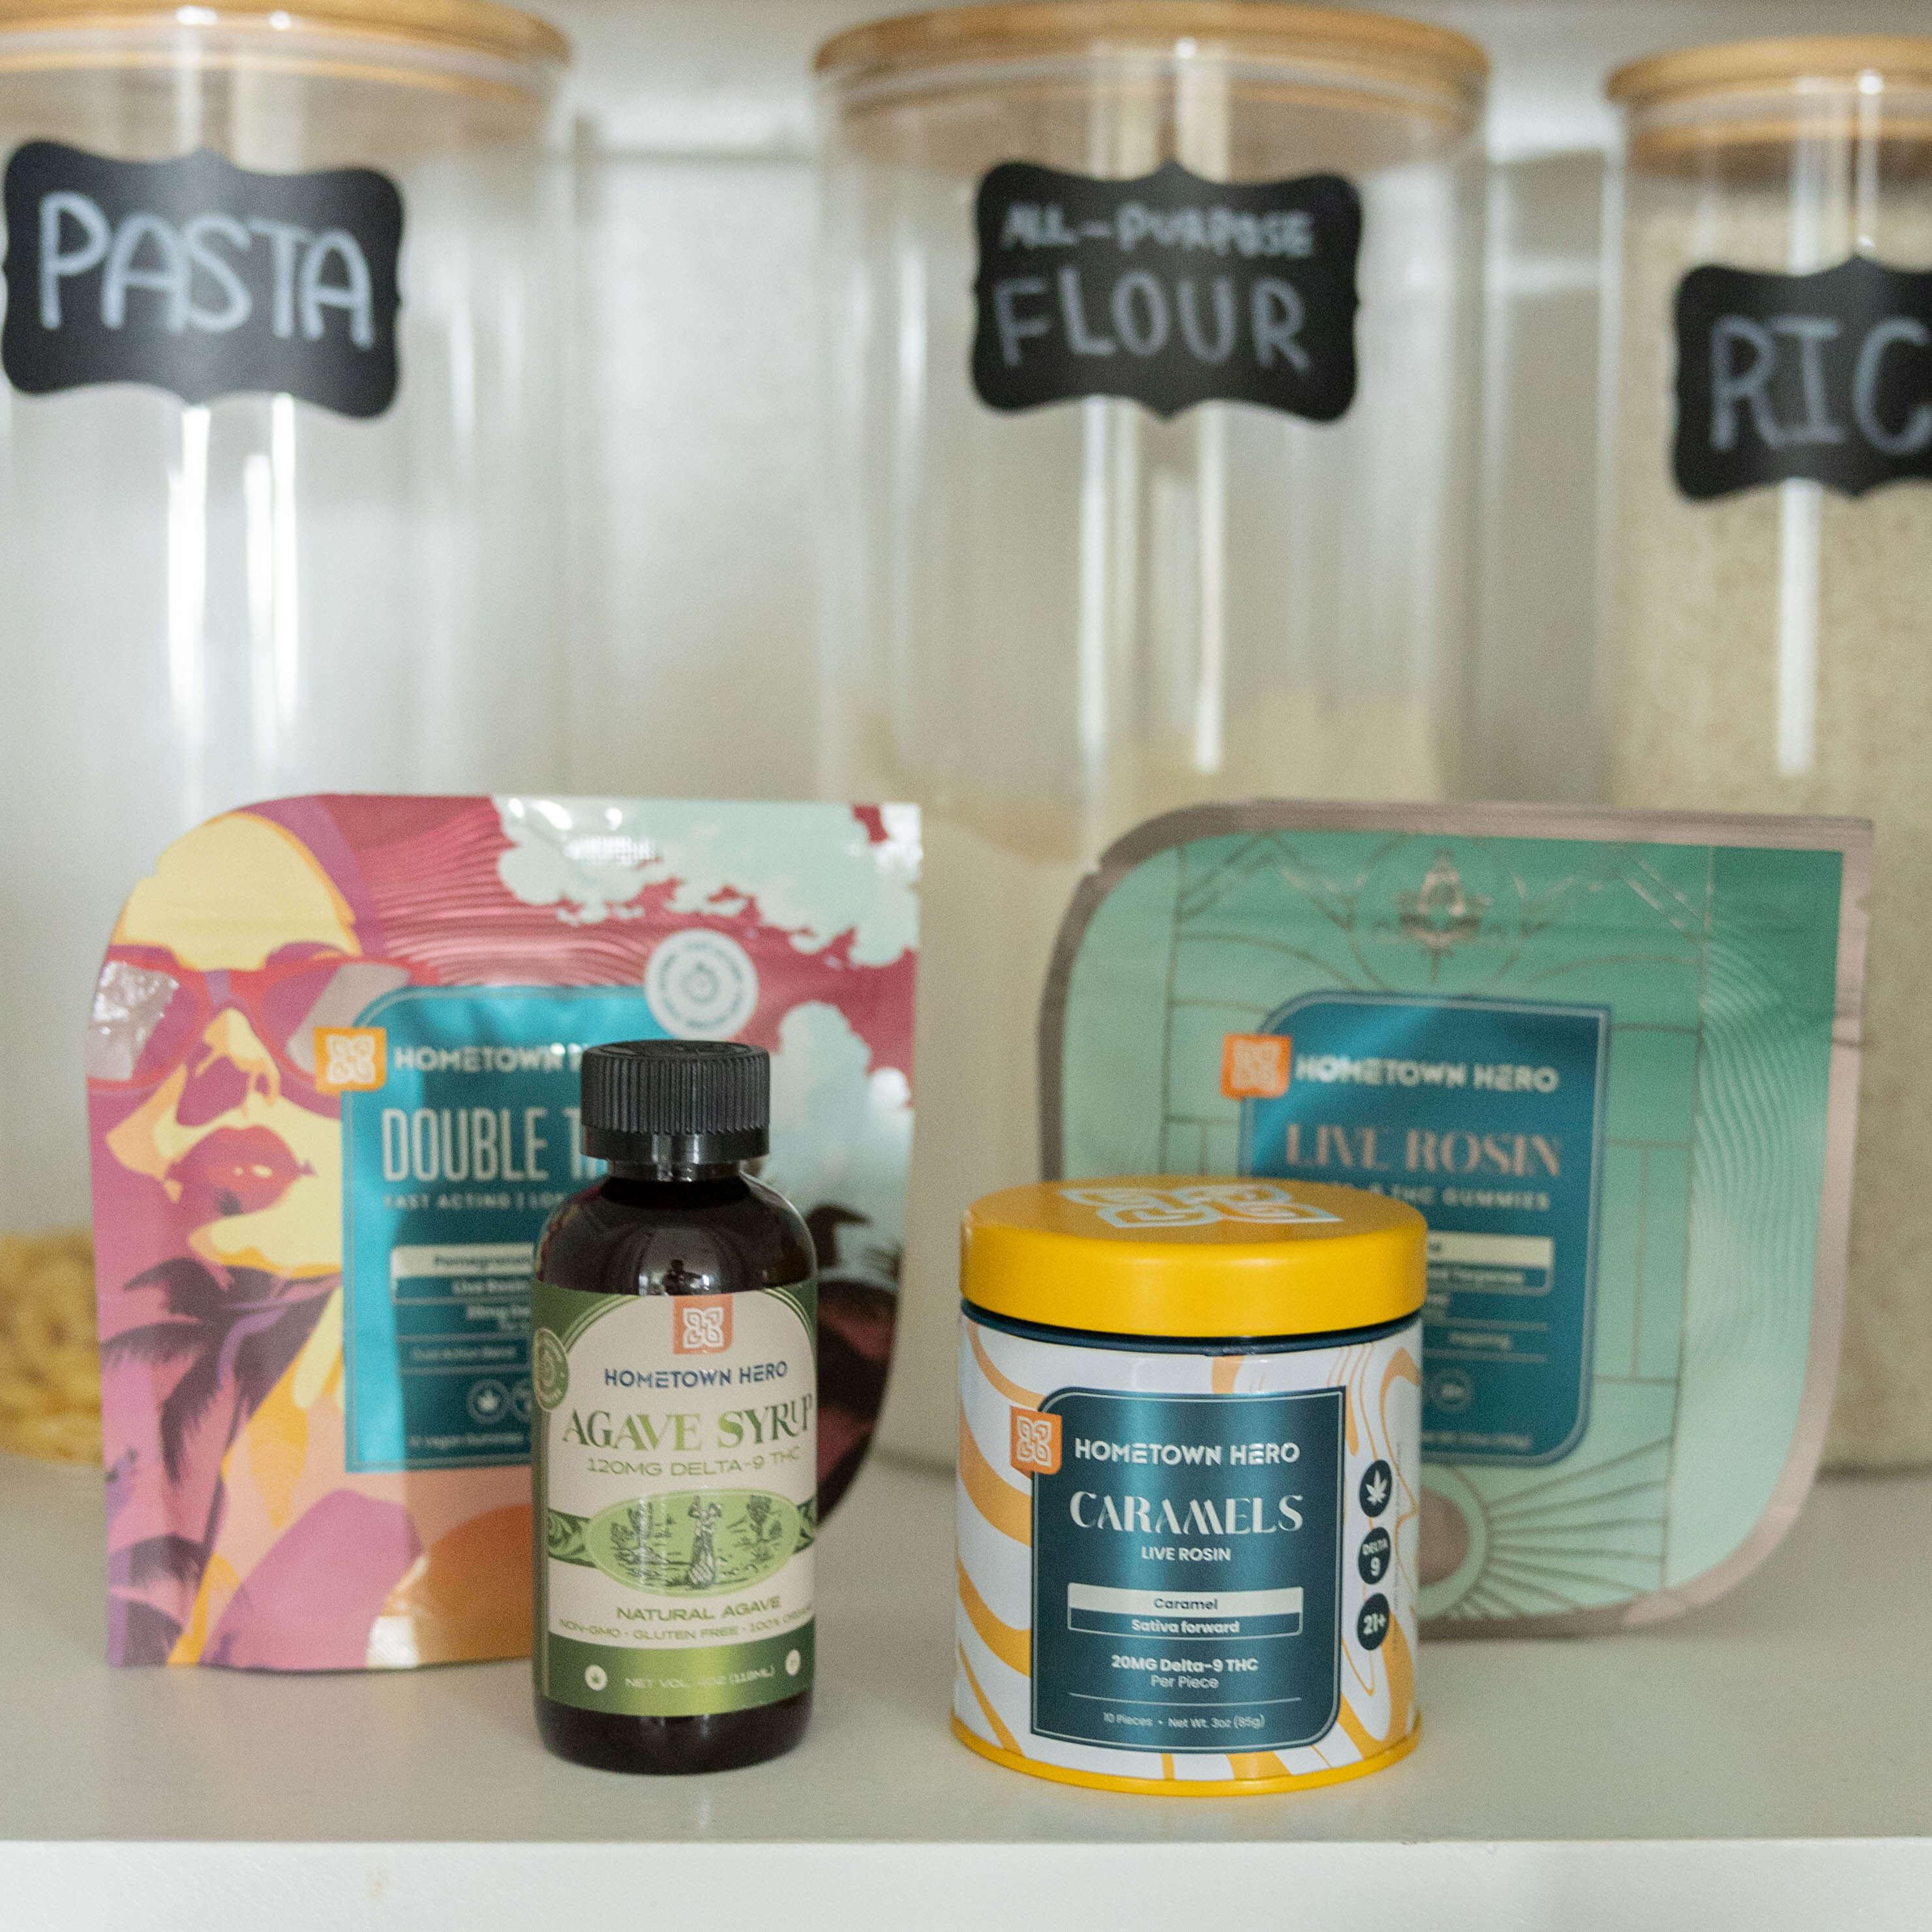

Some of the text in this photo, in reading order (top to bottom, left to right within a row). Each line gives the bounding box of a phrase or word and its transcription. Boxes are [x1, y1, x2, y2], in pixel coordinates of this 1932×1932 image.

[39, 191, 374, 349] PASTA
[993, 266, 1310, 376] FLOUR
[1709, 313, 1931, 455] RIC
[394, 1045, 563, 1072] HOMETOWN
[1295, 1055, 1560, 1094] HOMETOWN HERO
[382, 1107, 549, 1182] DOUBLE
[1285, 1122, 1562, 1177] LIVE ROSIN
[604, 1361, 788, 1389] HOMETOWN HERO
[562, 1392, 813, 1452] AGAVE SYRUP
[588, 1445, 801, 1476] 120MG DELTA-9 THC
[1074, 1438, 1301, 1466] HOMETOWN HERO
[1070, 1490, 1304, 1535] CARAMELS
[1141, 1546, 1231, 1562] LIVE ROSIN
[1370, 1556, 1381, 1577] 9
[616, 1607, 715, 1622] NATURAL
[721, 1596, 781, 1618] AGAVE
[1154, 1597, 1218, 1610] Caramel
[633, 1629, 696, 1640] GLUTEN
[700, 1625, 738, 1638] FREE
[1131, 1618, 1240, 1634] Sativa forward
[1363, 1612, 1387, 1635] 21+
[1111, 1654, 1260, 1673] 20MG Delta-9 THC
[1151, 1674, 1220, 1689] Per Piece
[1103, 1712, 1115, 1723] 10
[1116, 1713, 1153, 1727] Pieces
[1168, 1717, 1188, 1728] Net
